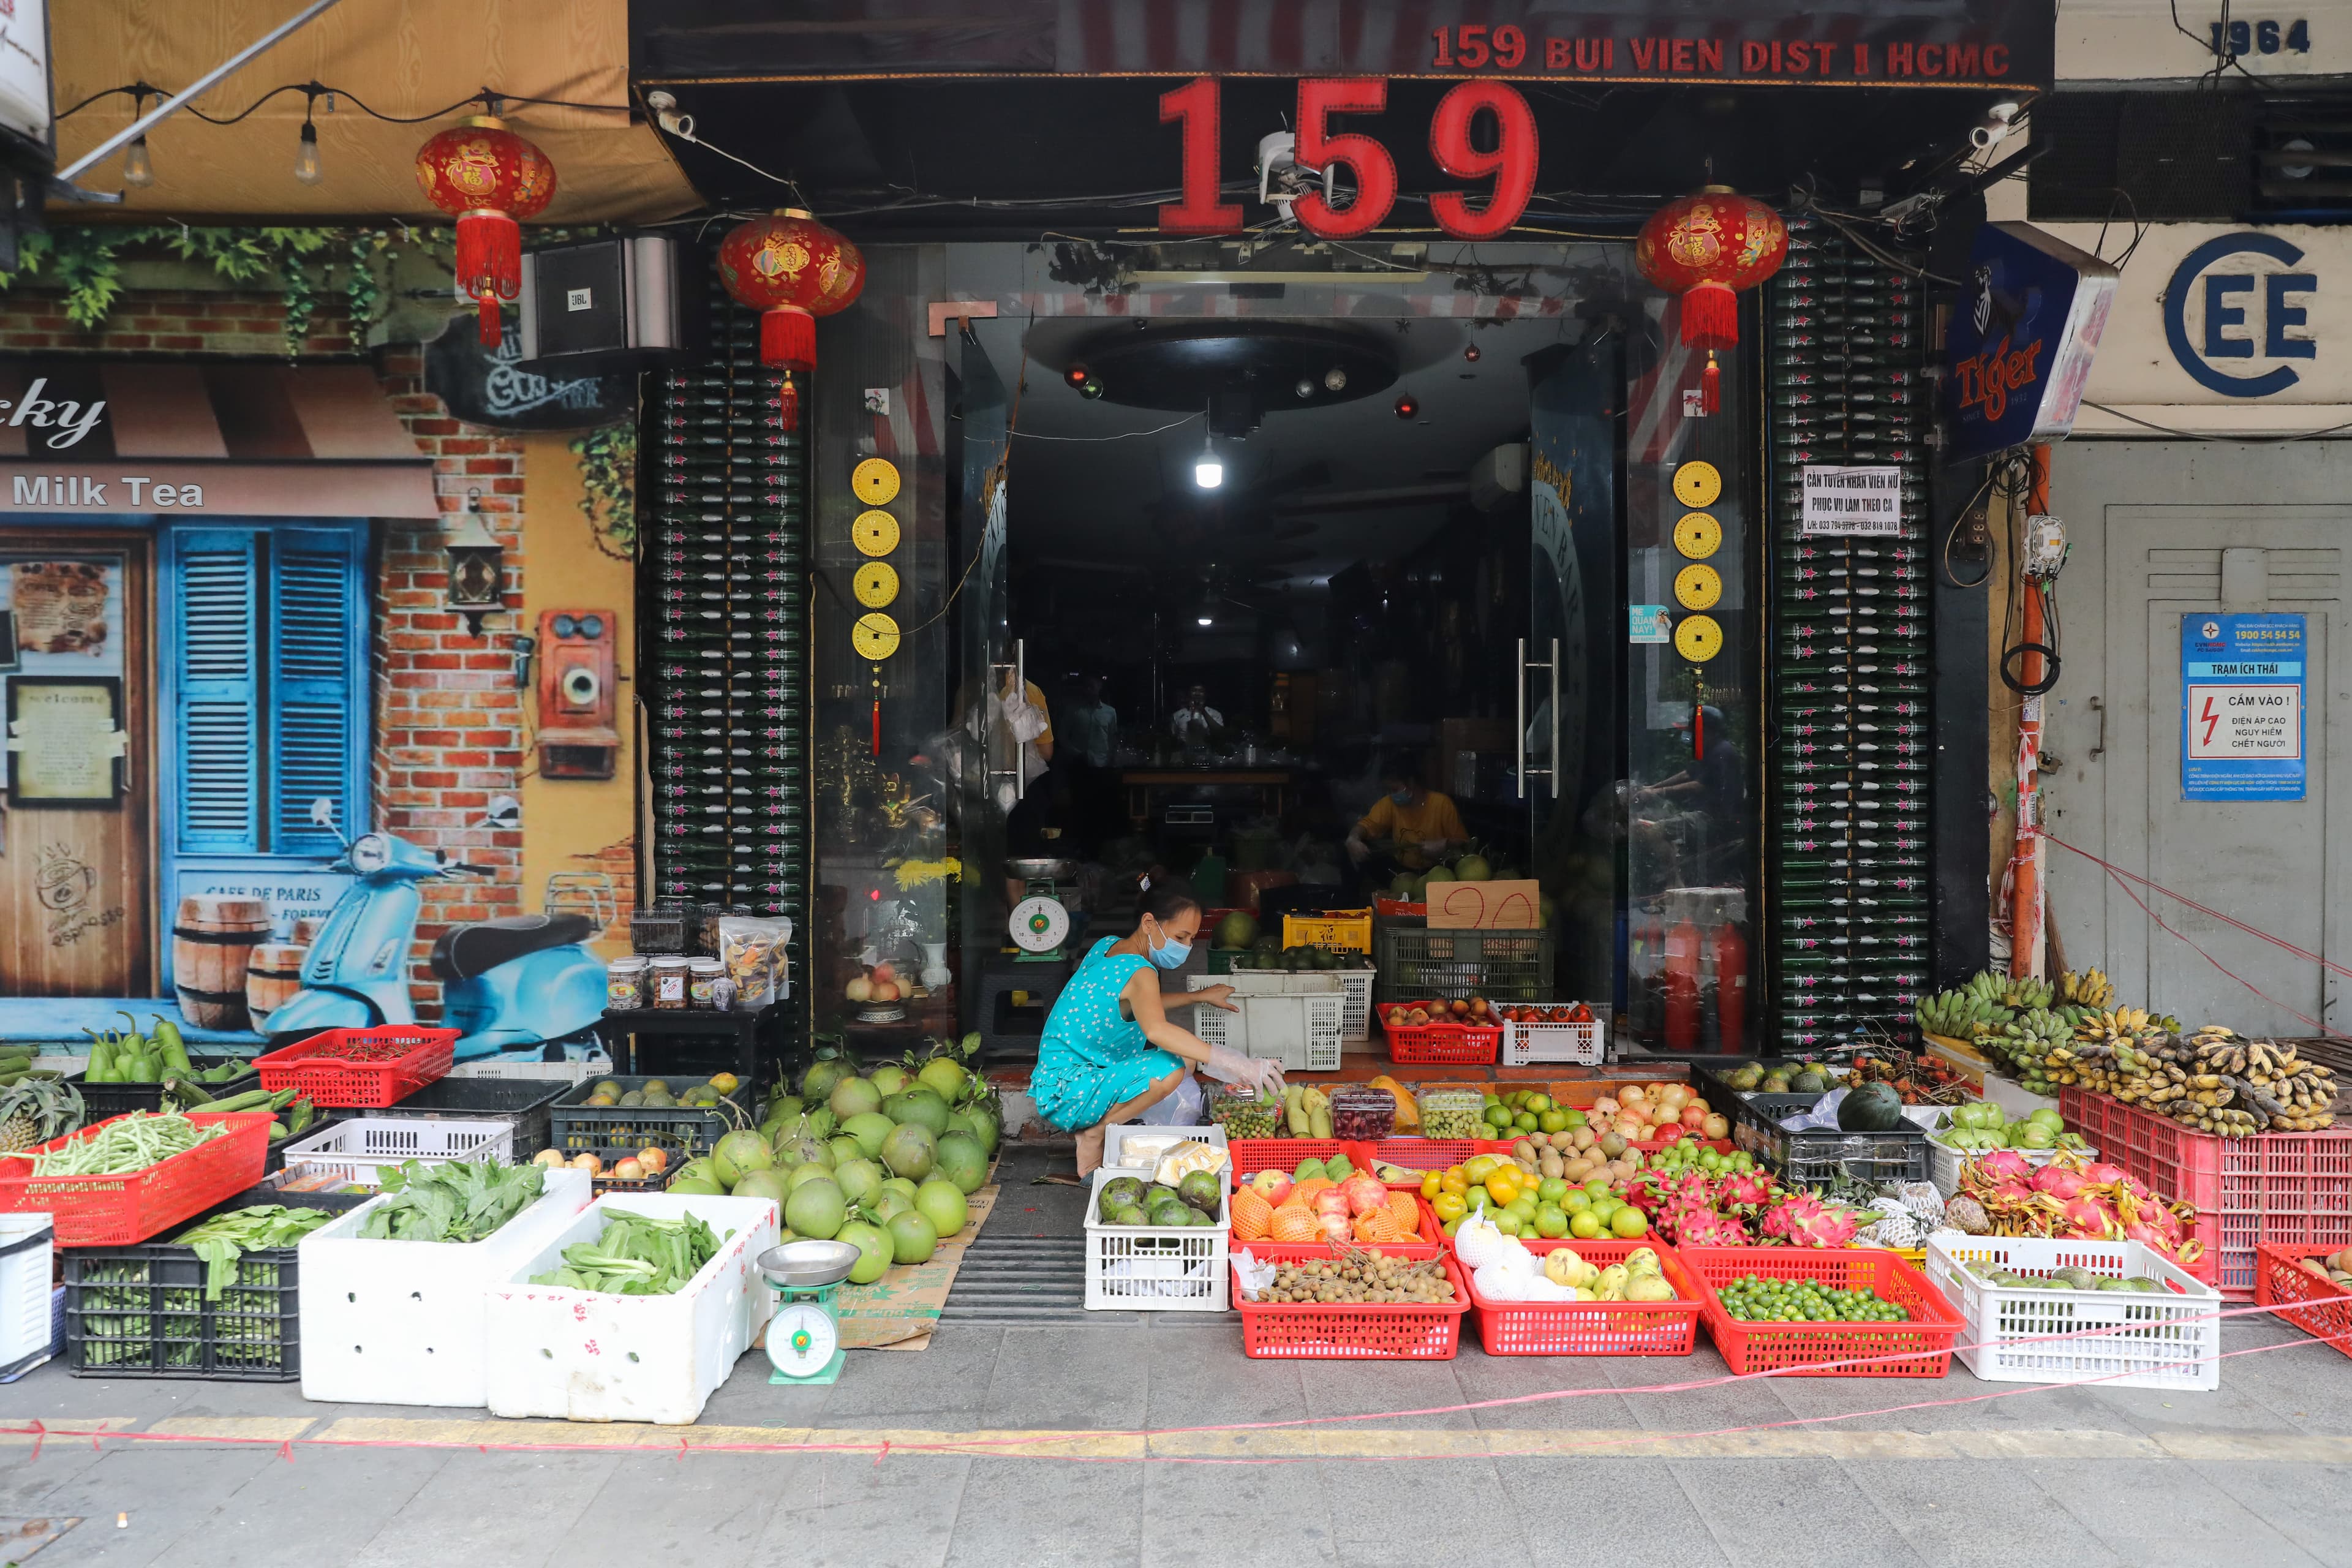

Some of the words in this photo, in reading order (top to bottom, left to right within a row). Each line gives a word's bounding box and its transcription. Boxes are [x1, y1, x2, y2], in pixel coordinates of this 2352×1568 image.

[2211, 20, 2311, 56] 1964
[1433, 24, 1526, 69] 159
[1545, 37, 1614, 70] BUI
[1630, 37, 1723, 72] VIEN
[1741, 40, 1838, 74] DIST
[1887, 42, 2010, 77] HCMC
[1158, 77, 1540, 241] 159
[1683, 236, 1706, 256] 福
[571, 293, 587, 306] JBL
[1955, 334, 2041, 421] Tiger
[1807, 469, 1821, 488] CẦN
[1823, 470, 1844, 488] TUYỂN
[1847, 473, 1866, 489] NHÂN
[1869, 473, 1885, 489] VIÊN
[1888, 473, 1899, 488] NỮ
[13, 475, 108, 506] Milk
[121, 477, 205, 507] Tea
[1812, 497, 1831, 514] PHỤC
[1834, 498, 1843, 514] VỤ
[1845, 497, 1860, 512] LÀM
[1862, 499, 1880, 512] THEO
[1883, 499, 1893, 512] CA
[1807, 521, 1817, 530] L/H:
[1820, 521, 1830, 530] 033
[1861, 521, 1871, 530] 032
[1872, 522, 1883, 530] 819
[1885, 522, 1898, 530] 1078
[2235, 631, 2258, 639] 1900
[2261, 631, 2272, 639] 54
[2275, 631, 2286, 639] 54
[2288, 631, 2300, 639] 54
[2212, 664, 2237, 677] TRẠM
[2240, 662, 2255, 674] ÍCH
[2257, 662, 2278, 674] THÁI
[2229, 693, 2254, 706] CẤM
[2259, 694, 2283, 706] VÀO
[2232, 717, 2252, 726] ĐIỆN
[2262, 727, 2282, 736] HIỂM
[2232, 738, 2254, 747] CHẾT
[277, 888, 322, 901] PARIS
